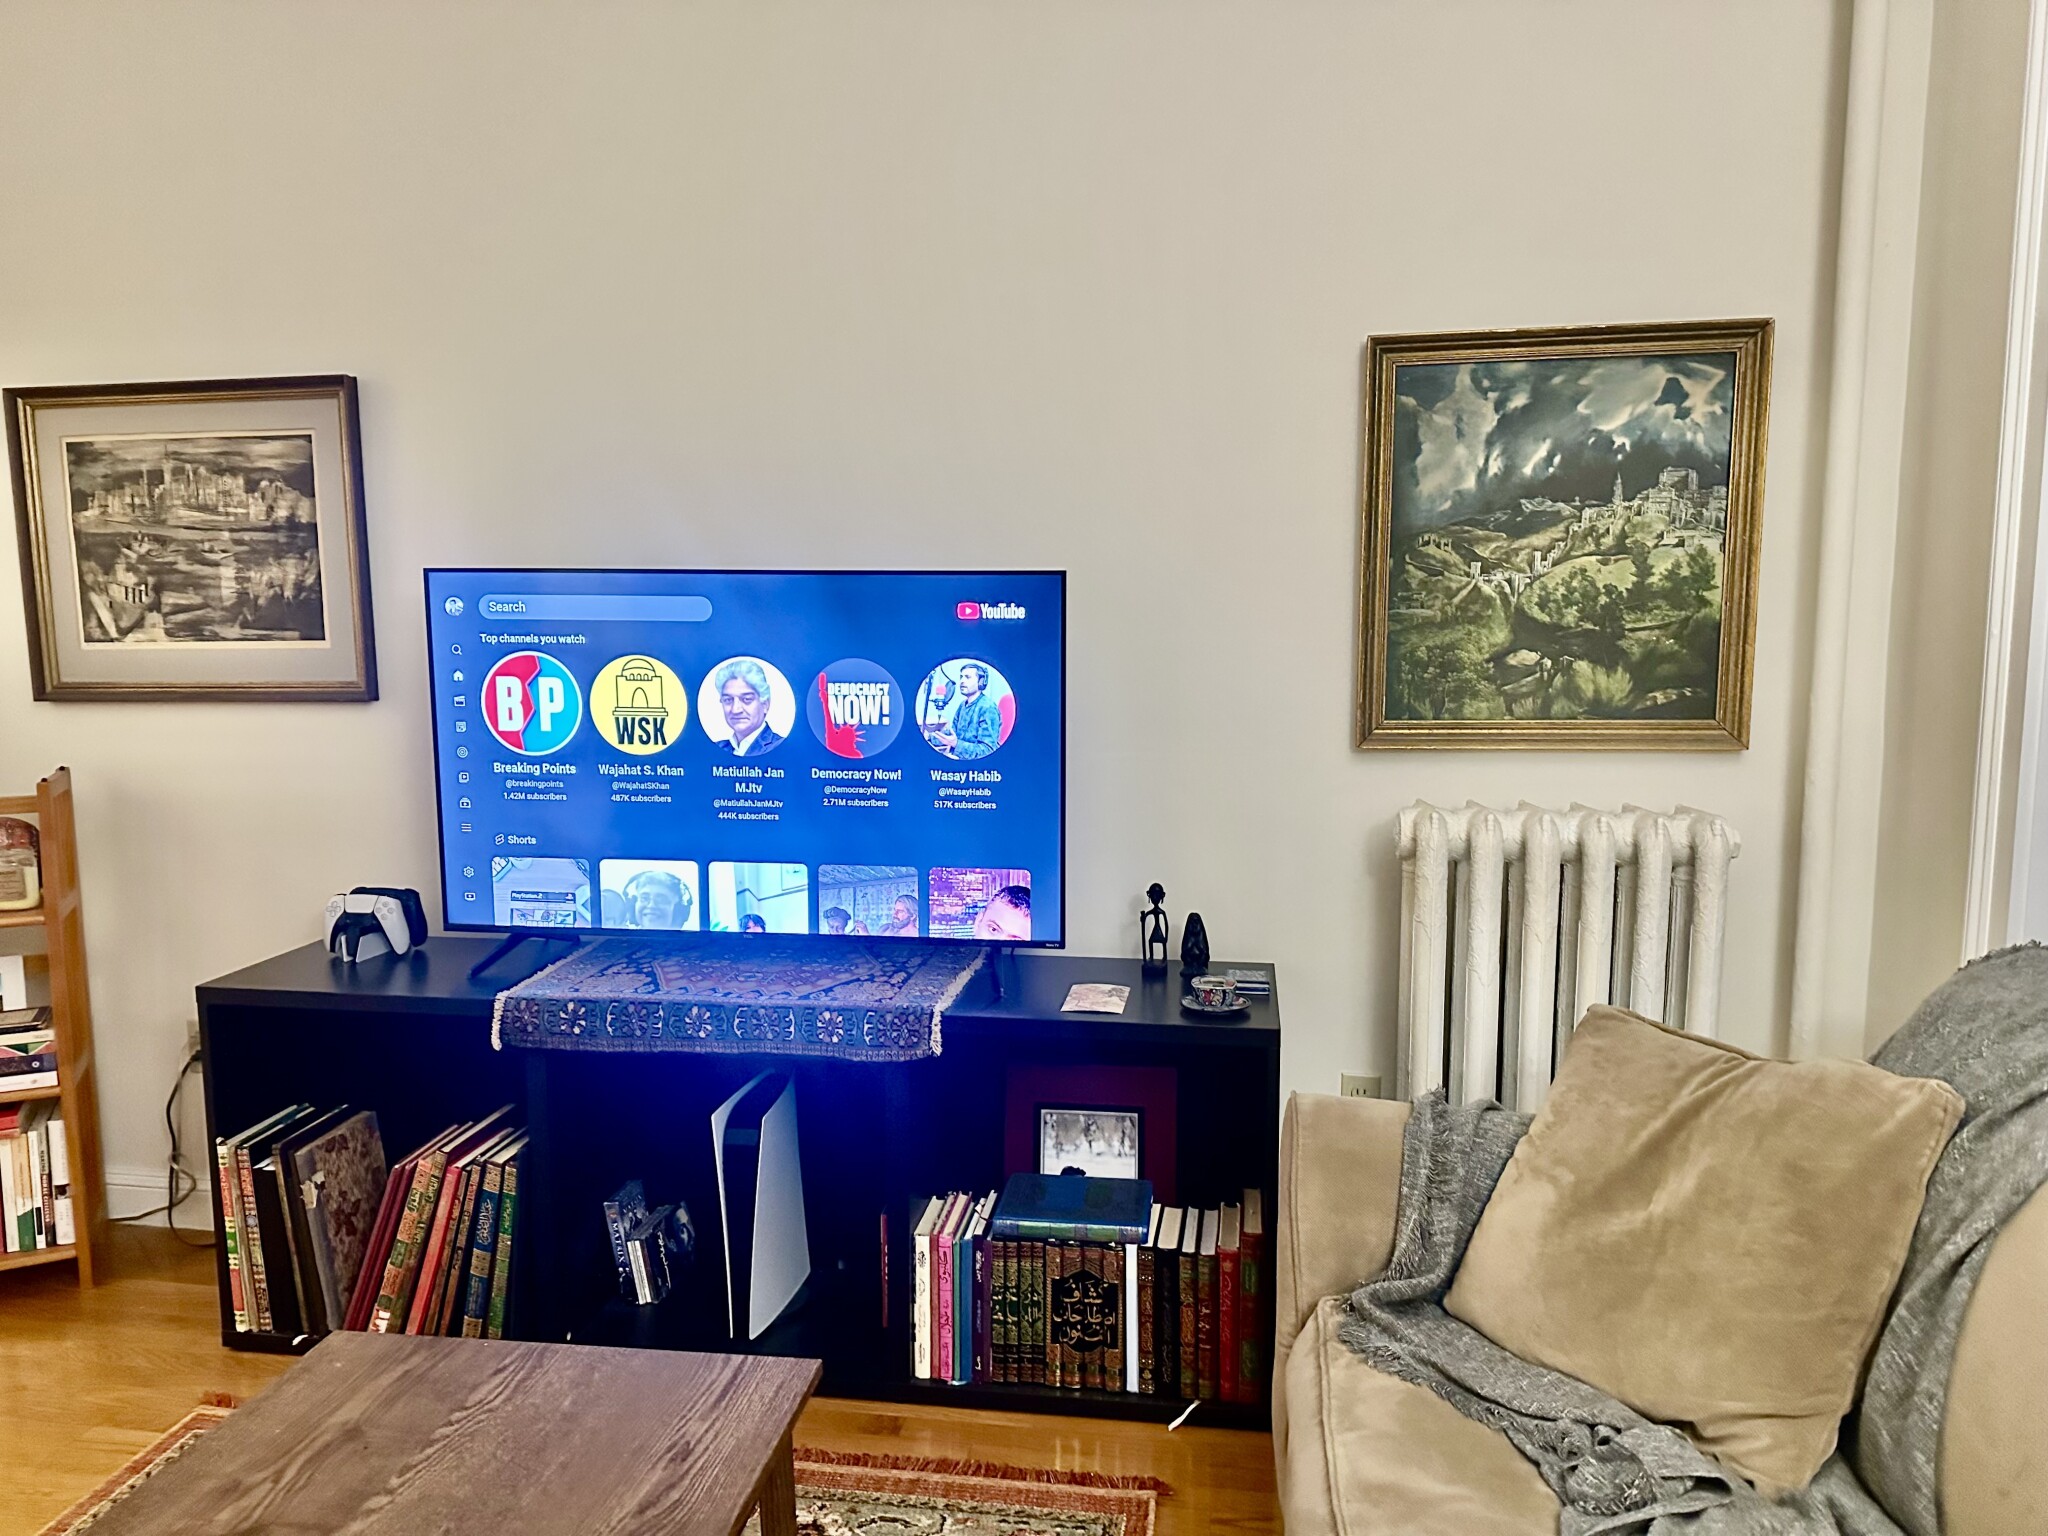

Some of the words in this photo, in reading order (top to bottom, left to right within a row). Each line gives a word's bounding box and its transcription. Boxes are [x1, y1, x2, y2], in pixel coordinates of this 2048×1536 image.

[488, 601, 526, 613] Search
[980, 602, 1026, 620] YouTube
[480, 633, 498, 645] Top
[499, 633, 539, 644] channels
[540, 635, 557, 645] you
[558, 634, 586, 644] watch
[828, 682, 890, 696] DEMOCRACY
[829, 695, 890, 726] NOW!
[615, 716, 668, 746] WSK
[493, 762, 541, 775] Breaking
[542, 763, 577, 775] Points
[598, 764, 643, 777] Wajahat
[644, 765, 655, 776] S.
[656, 765, 684, 777] Khan
[712, 766, 762, 778] Matiullah
[764, 767, 784, 778] Jan
[811, 768, 872, 782] Democracy
[873, 768, 902, 781] Now!
[930, 769, 967, 784] Wasay
[969, 770, 1002, 782] Habib
[505, 778, 564, 789] @breakingpoints
[611, 780, 670, 791] @WajahatSKhan
[735, 783, 763, 794] MJtv
[824, 785, 888, 796] @DemocracyNow
[938, 787, 992, 798] @WasayHabib
[503, 791, 525, 801] 1.42M
[526, 792, 567, 802] subscribers
[611, 793, 630, 803] 487K
[631, 793, 672, 803] subscribers
[713, 798, 783, 809] @MatiullahJanMJtv
[823, 798, 846, 807] 2.71M
[847, 798, 889, 808] subscribers
[934, 800, 953, 809] 517K
[954, 800, 997, 810] subscribers
[718, 811, 737, 820] 444K
[737, 812, 779, 821] subscribers
[507, 834, 537, 845] Shorts
[611, 1221, 626, 1263] MATRIX
